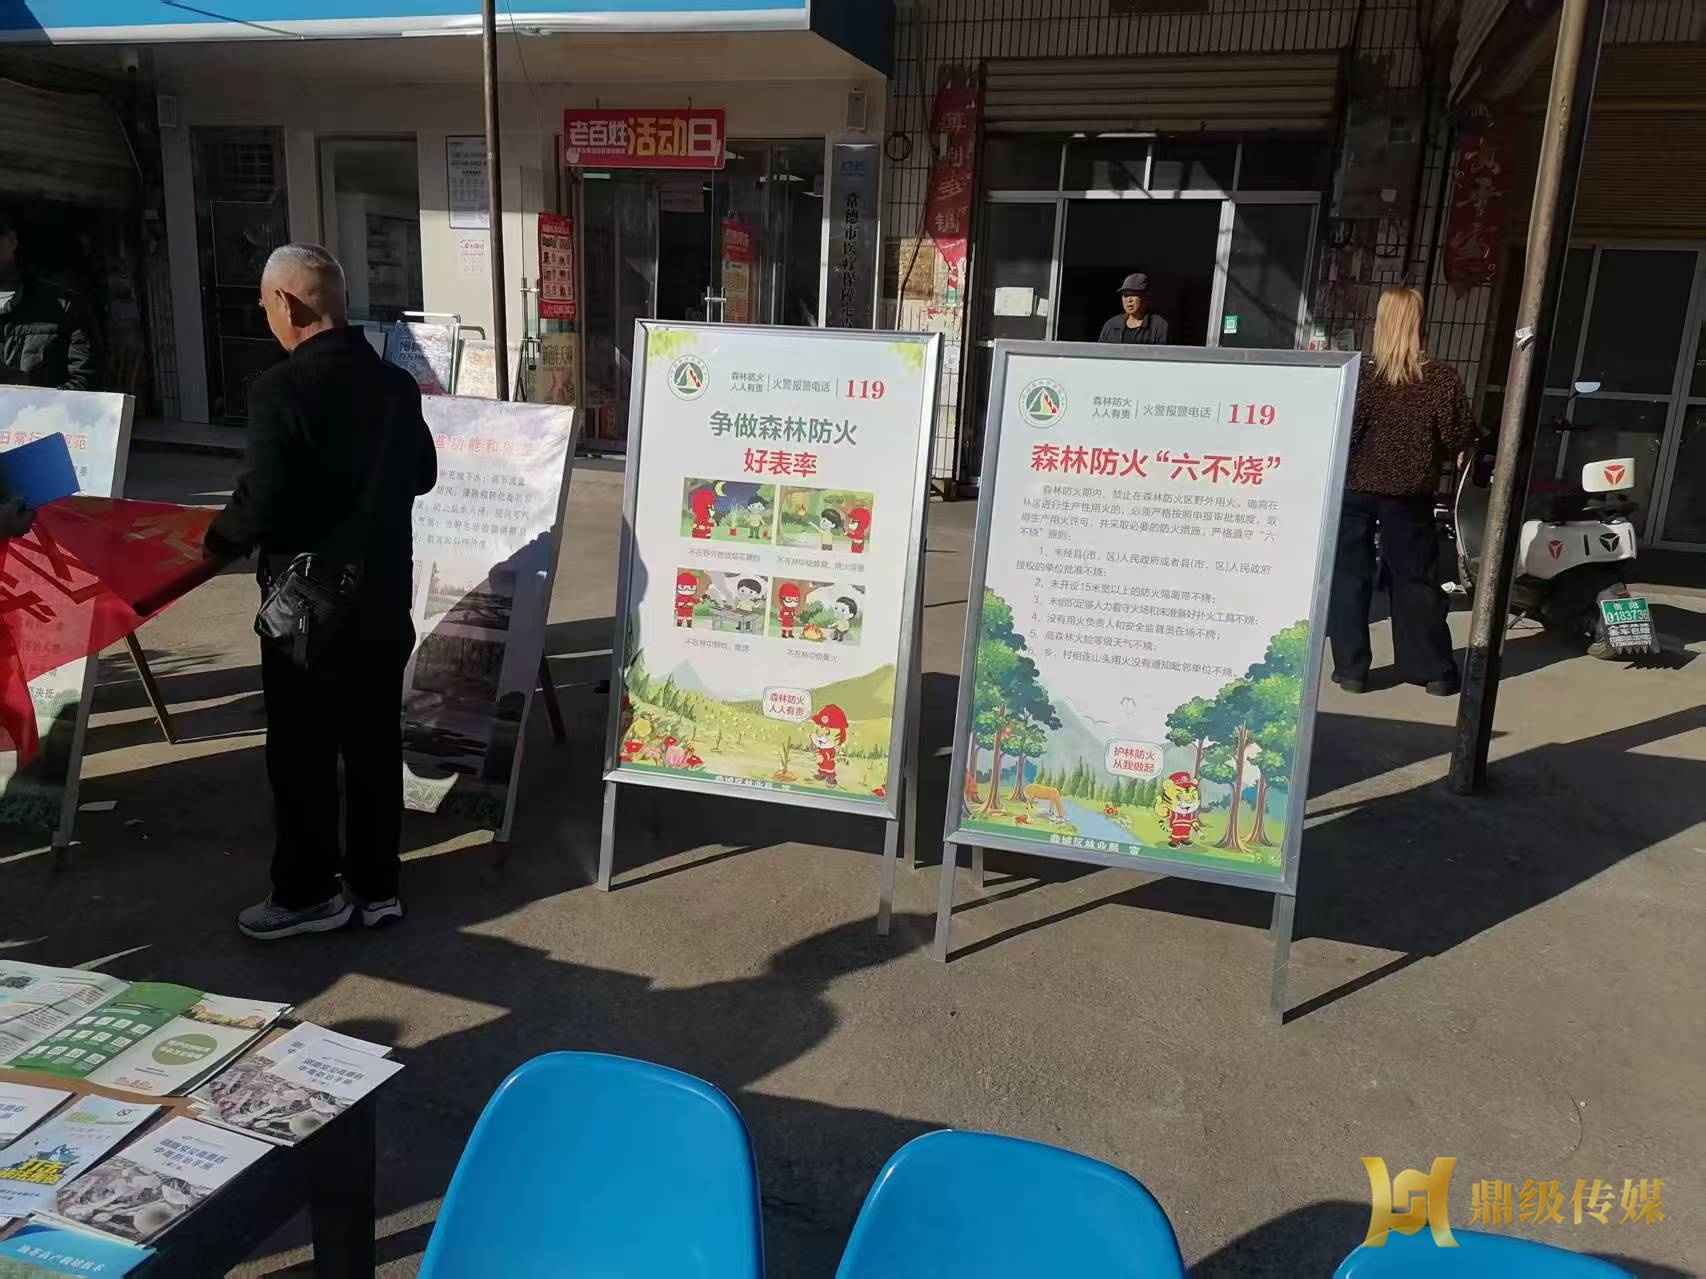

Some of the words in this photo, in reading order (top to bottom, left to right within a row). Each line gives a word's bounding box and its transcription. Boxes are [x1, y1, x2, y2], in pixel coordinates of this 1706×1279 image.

[569, 117, 721, 160] 老百姓活动日
[731, 371, 764, 382] 森林防火
[730, 383, 763, 393] 人人有责
[772, 379, 831, 392] 火警报警电话
[845, 379, 885, 399] 119
[1092, 396, 1131, 408] 森林防火
[1092, 408, 1130, 419] 人人有责
[1142, 404, 1212, 419] 火警报警电话
[1227, 403, 1276, 425] 119
[709, 410, 858, 446] 争做森林防火
[744, 448, 817, 478] 好表率
[1030, 443, 1281, 486] 森林防火“六不烧”
[768, 692, 805, 705] 森林防火
[768, 704, 805, 717] 人人有责
[1113, 746, 1157, 761] 护林防火
[1112, 759, 1155, 773] 从我做起
